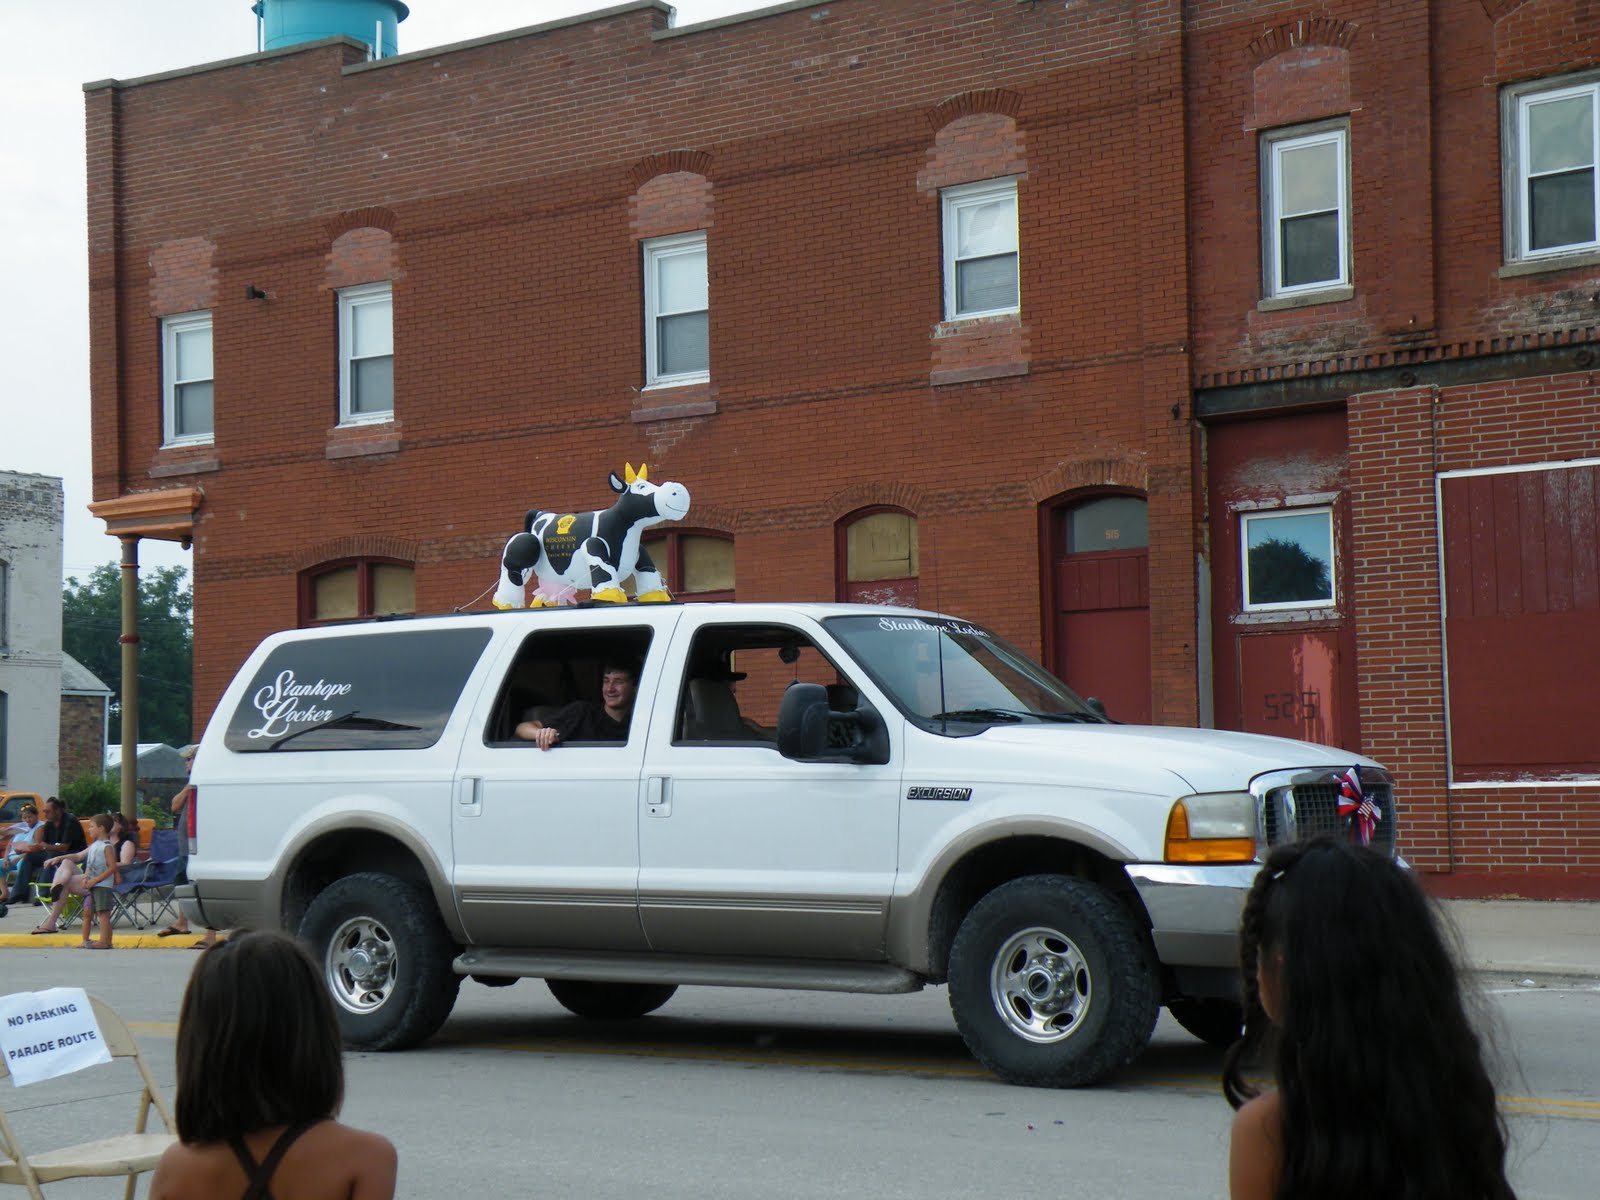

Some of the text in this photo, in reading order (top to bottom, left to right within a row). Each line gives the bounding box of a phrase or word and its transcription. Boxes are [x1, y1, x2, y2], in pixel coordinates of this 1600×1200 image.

[1104, 528, 1120, 540] 515
[879, 617, 950, 633] Stanhope
[253, 669, 352, 710] Stanhope
[247, 696, 333, 739] Locker
[1264, 691, 1316, 721] 525
[907, 787, 972, 800] EXCURSION
[7, 1003, 78, 1027] NO PARKING
[8, 1030, 97, 1060] PARADE ROUTE
